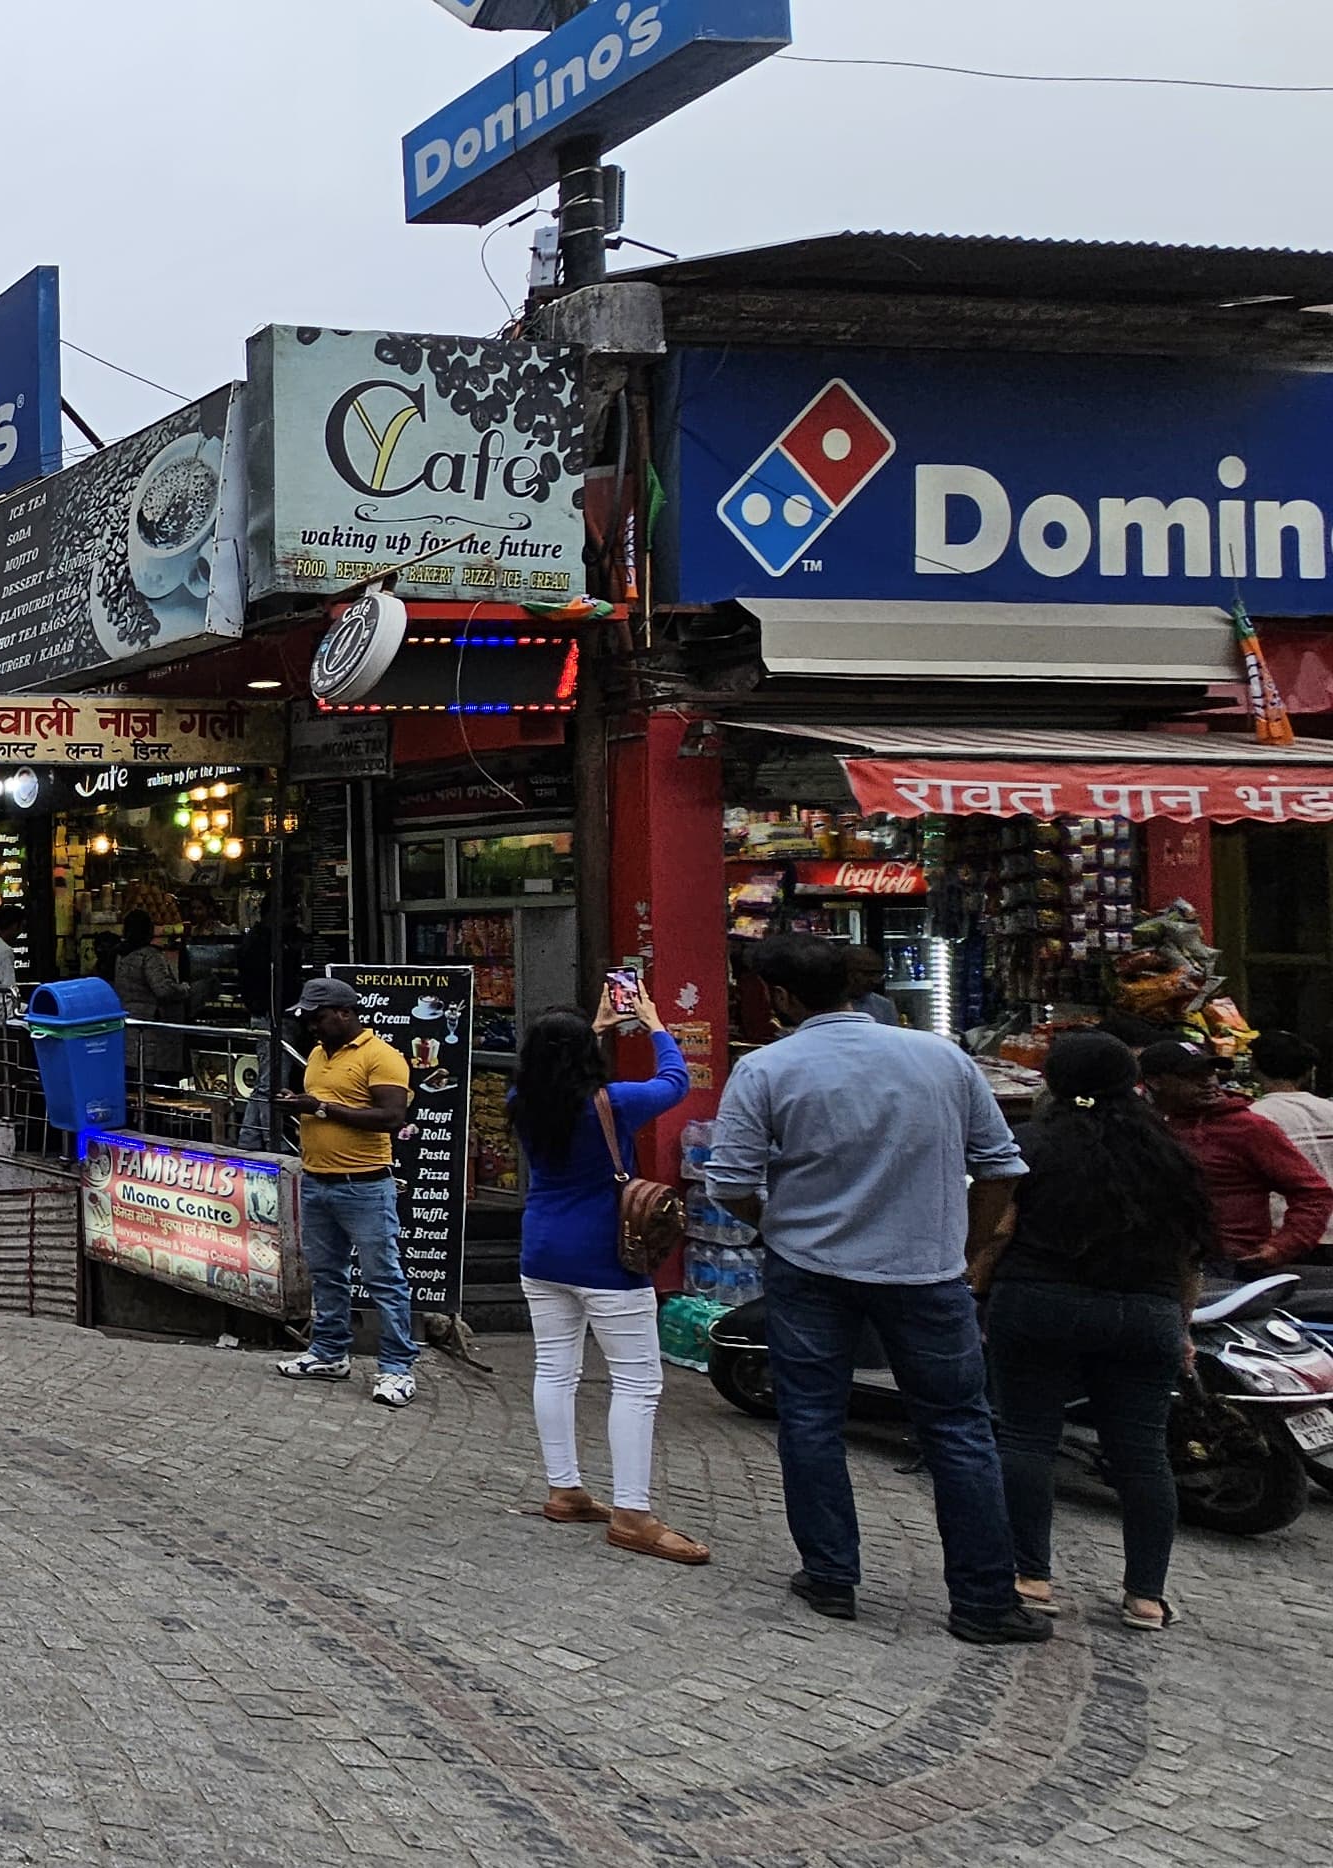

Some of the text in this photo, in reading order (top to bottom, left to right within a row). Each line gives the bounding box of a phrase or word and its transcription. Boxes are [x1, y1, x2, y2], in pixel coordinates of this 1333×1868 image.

[414, 2, 663, 197] Domino's
[8, 492, 48, 521] ICE TEA
[914, 455, 1333, 580] Domin
[6, 525, 32, 547] SODA
[300, 526, 378, 554] waking
[386, 533, 411, 556] up
[495, 535, 563, 561] future
[3, 547, 40, 574] MOJITO
[801, 560, 823, 572] TM
[295, 559, 327, 578] FOOD
[407, 565, 456, 585] BAKERY
[462, 567, 496, 586] PIZZA
[1, 570, 46, 600] DESSERT
[17, 624, 39, 643] TEA
[39, 614, 68, 635] BAGS
[38, 639, 75, 662] KABAB
[94, 707, 164, 738] नाज
[175, 699, 249, 742] गली
[64, 742, 104, 761] लन्च
[129, 738, 173, 761] डिनर
[893, 777, 1062, 814] रावत
[1087, 783, 1210, 818] पान
[355, 974, 449, 987] SPECIALITY IN
[373, 1011, 411, 1025] Cream
[416, 1108, 454, 1124] Maggi
[420, 1127, 452, 1142] Rolls
[417, 1147, 451, 1161] Pasta
[116, 1146, 237, 1197] FAMBELLS
[417, 1167, 450, 1181] Pizza
[122, 1184, 233, 1225] Momo Centre
[412, 1187, 450, 1201] Kabab
[411, 1206, 450, 1223] Waffle
[413, 1227, 449, 1240] Bread
[404, 1246, 448, 1260] Sundae
[406, 1266, 447, 1282] Scoops
[416, 1287, 447, 1302] Chai
